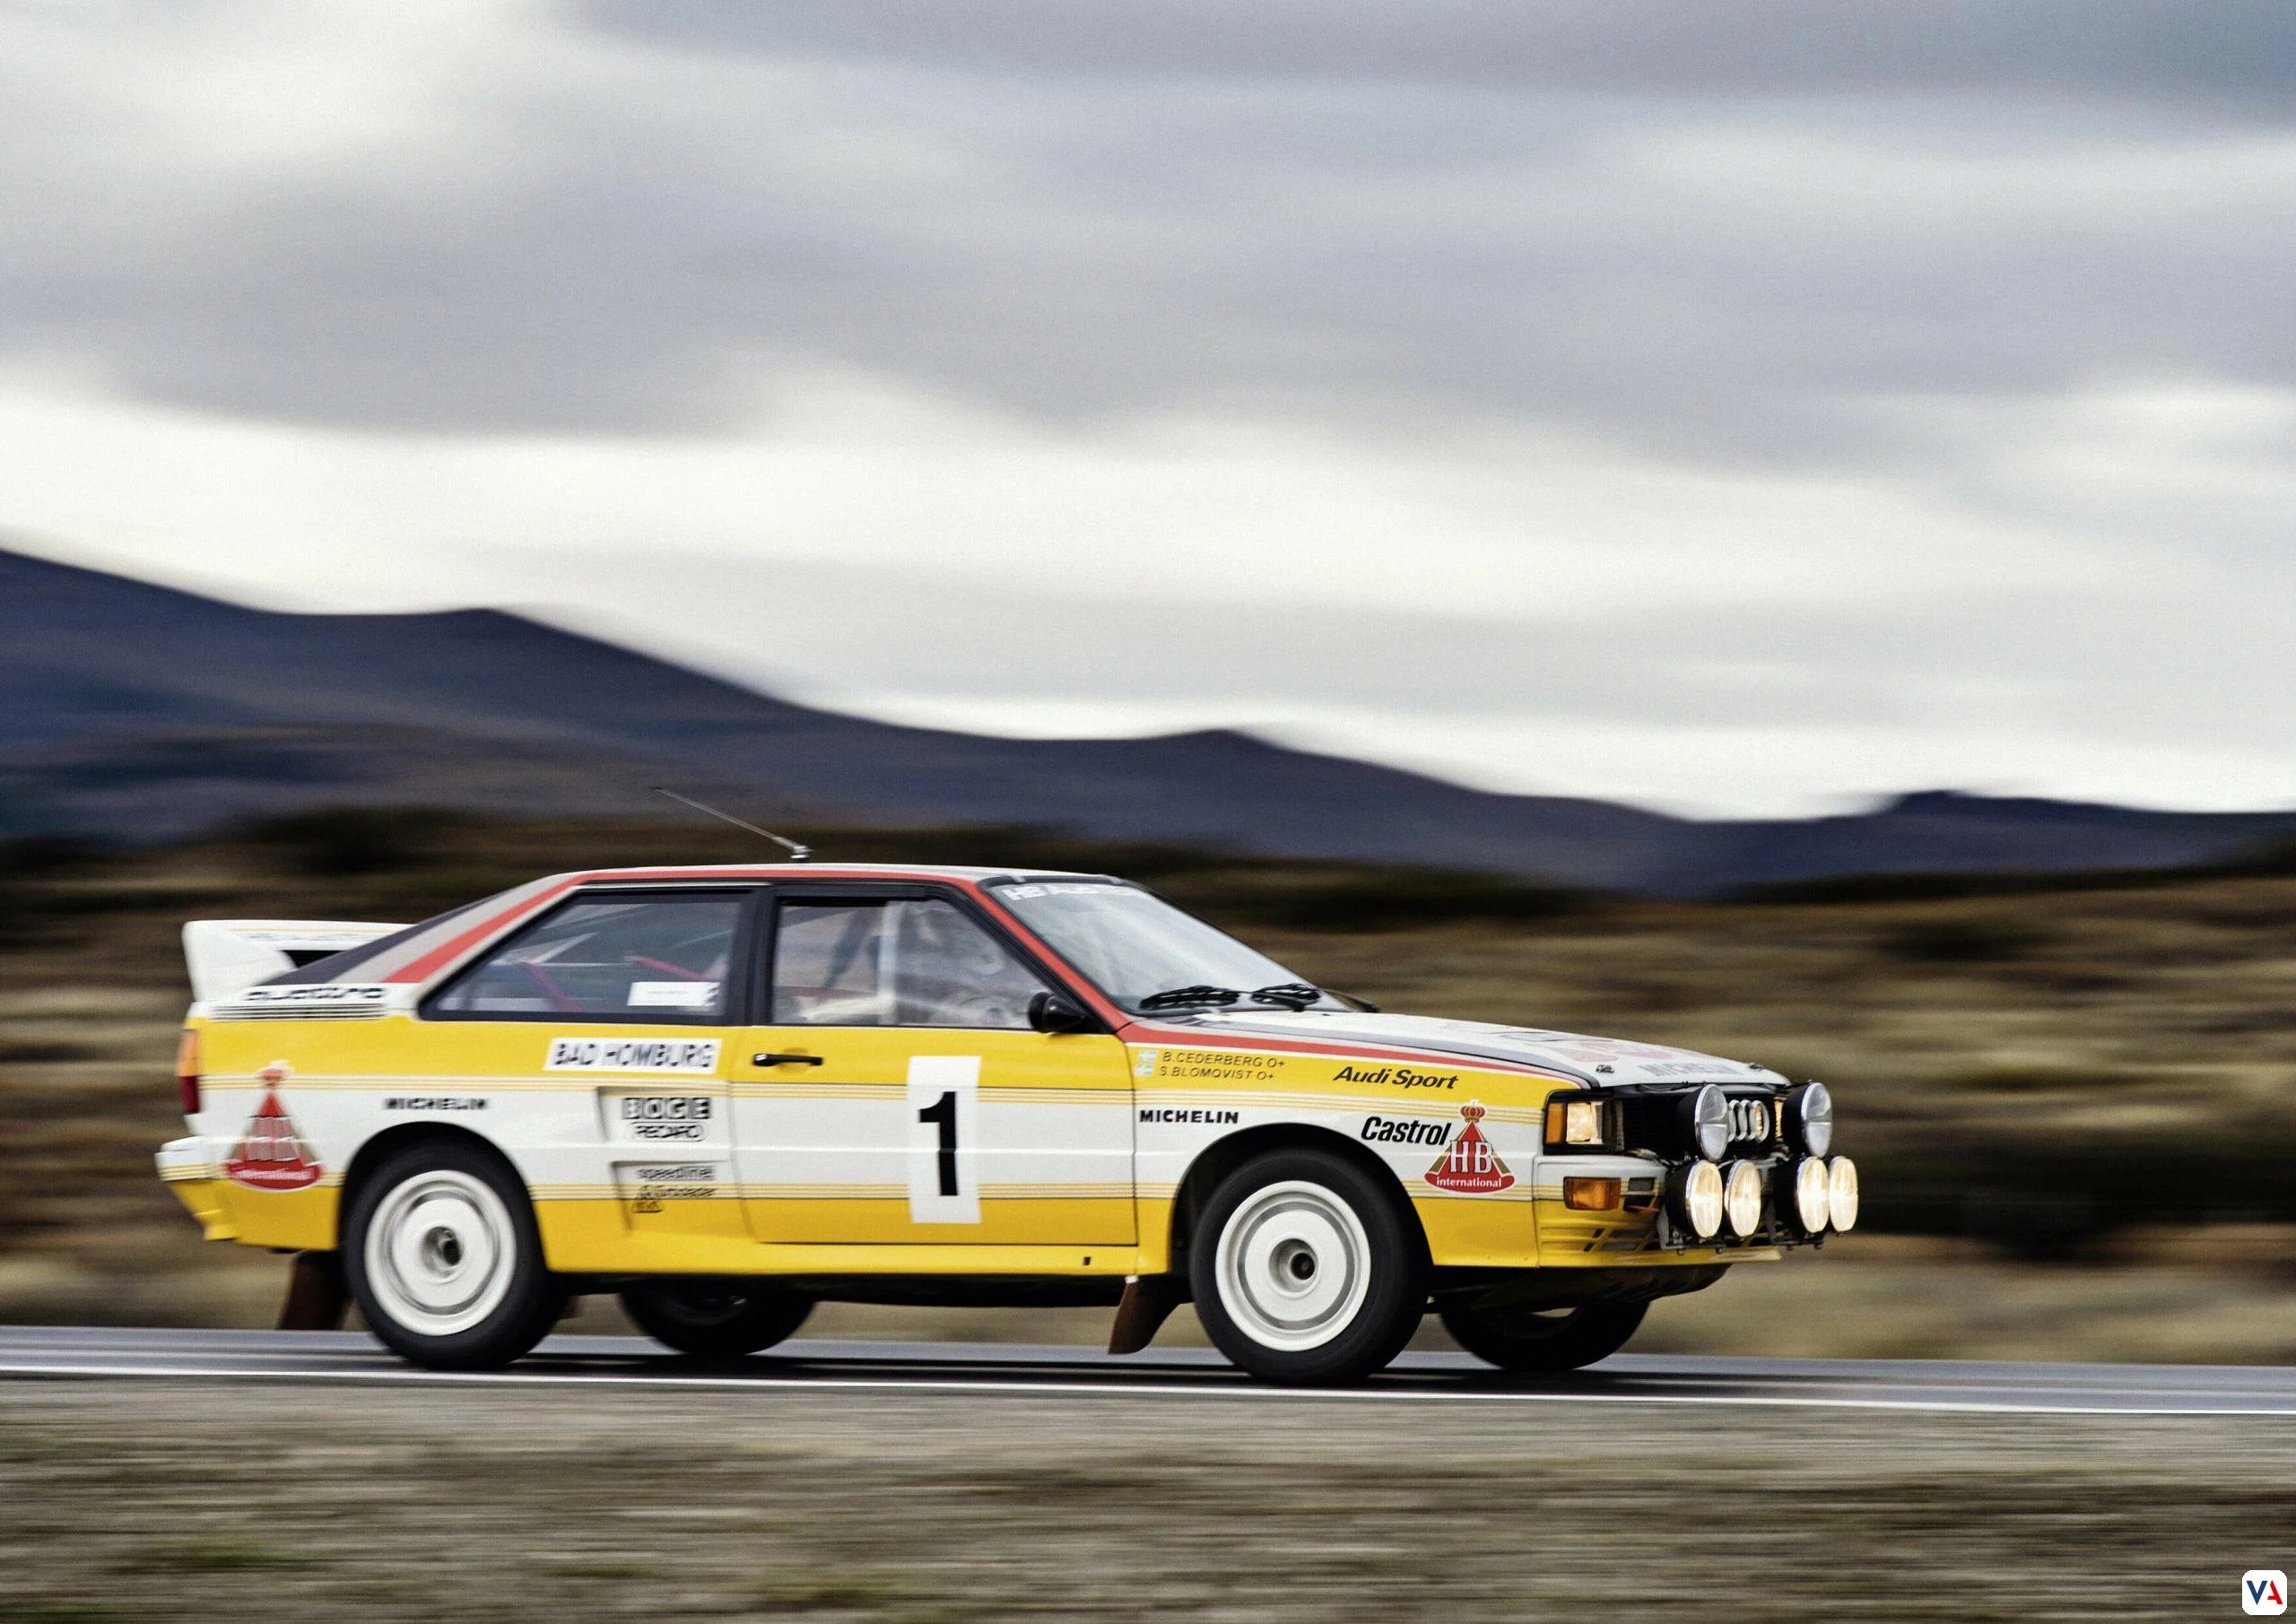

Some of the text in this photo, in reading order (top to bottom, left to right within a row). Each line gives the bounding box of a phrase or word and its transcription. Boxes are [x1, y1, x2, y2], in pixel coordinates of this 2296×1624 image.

[555, 1044, 713, 1067] BAD HOMBURG
[1333, 1066, 1458, 1089] Audi Sport
[623, 1097, 710, 1119] BOGE
[1140, 1109, 1239, 1124] MICHELIN
[1361, 1116, 1452, 1145] Castrol
[918, 1091, 959, 1196] 1
[1450, 1140, 1493, 1174] HB
[1436, 1177, 1501, 1187] international
